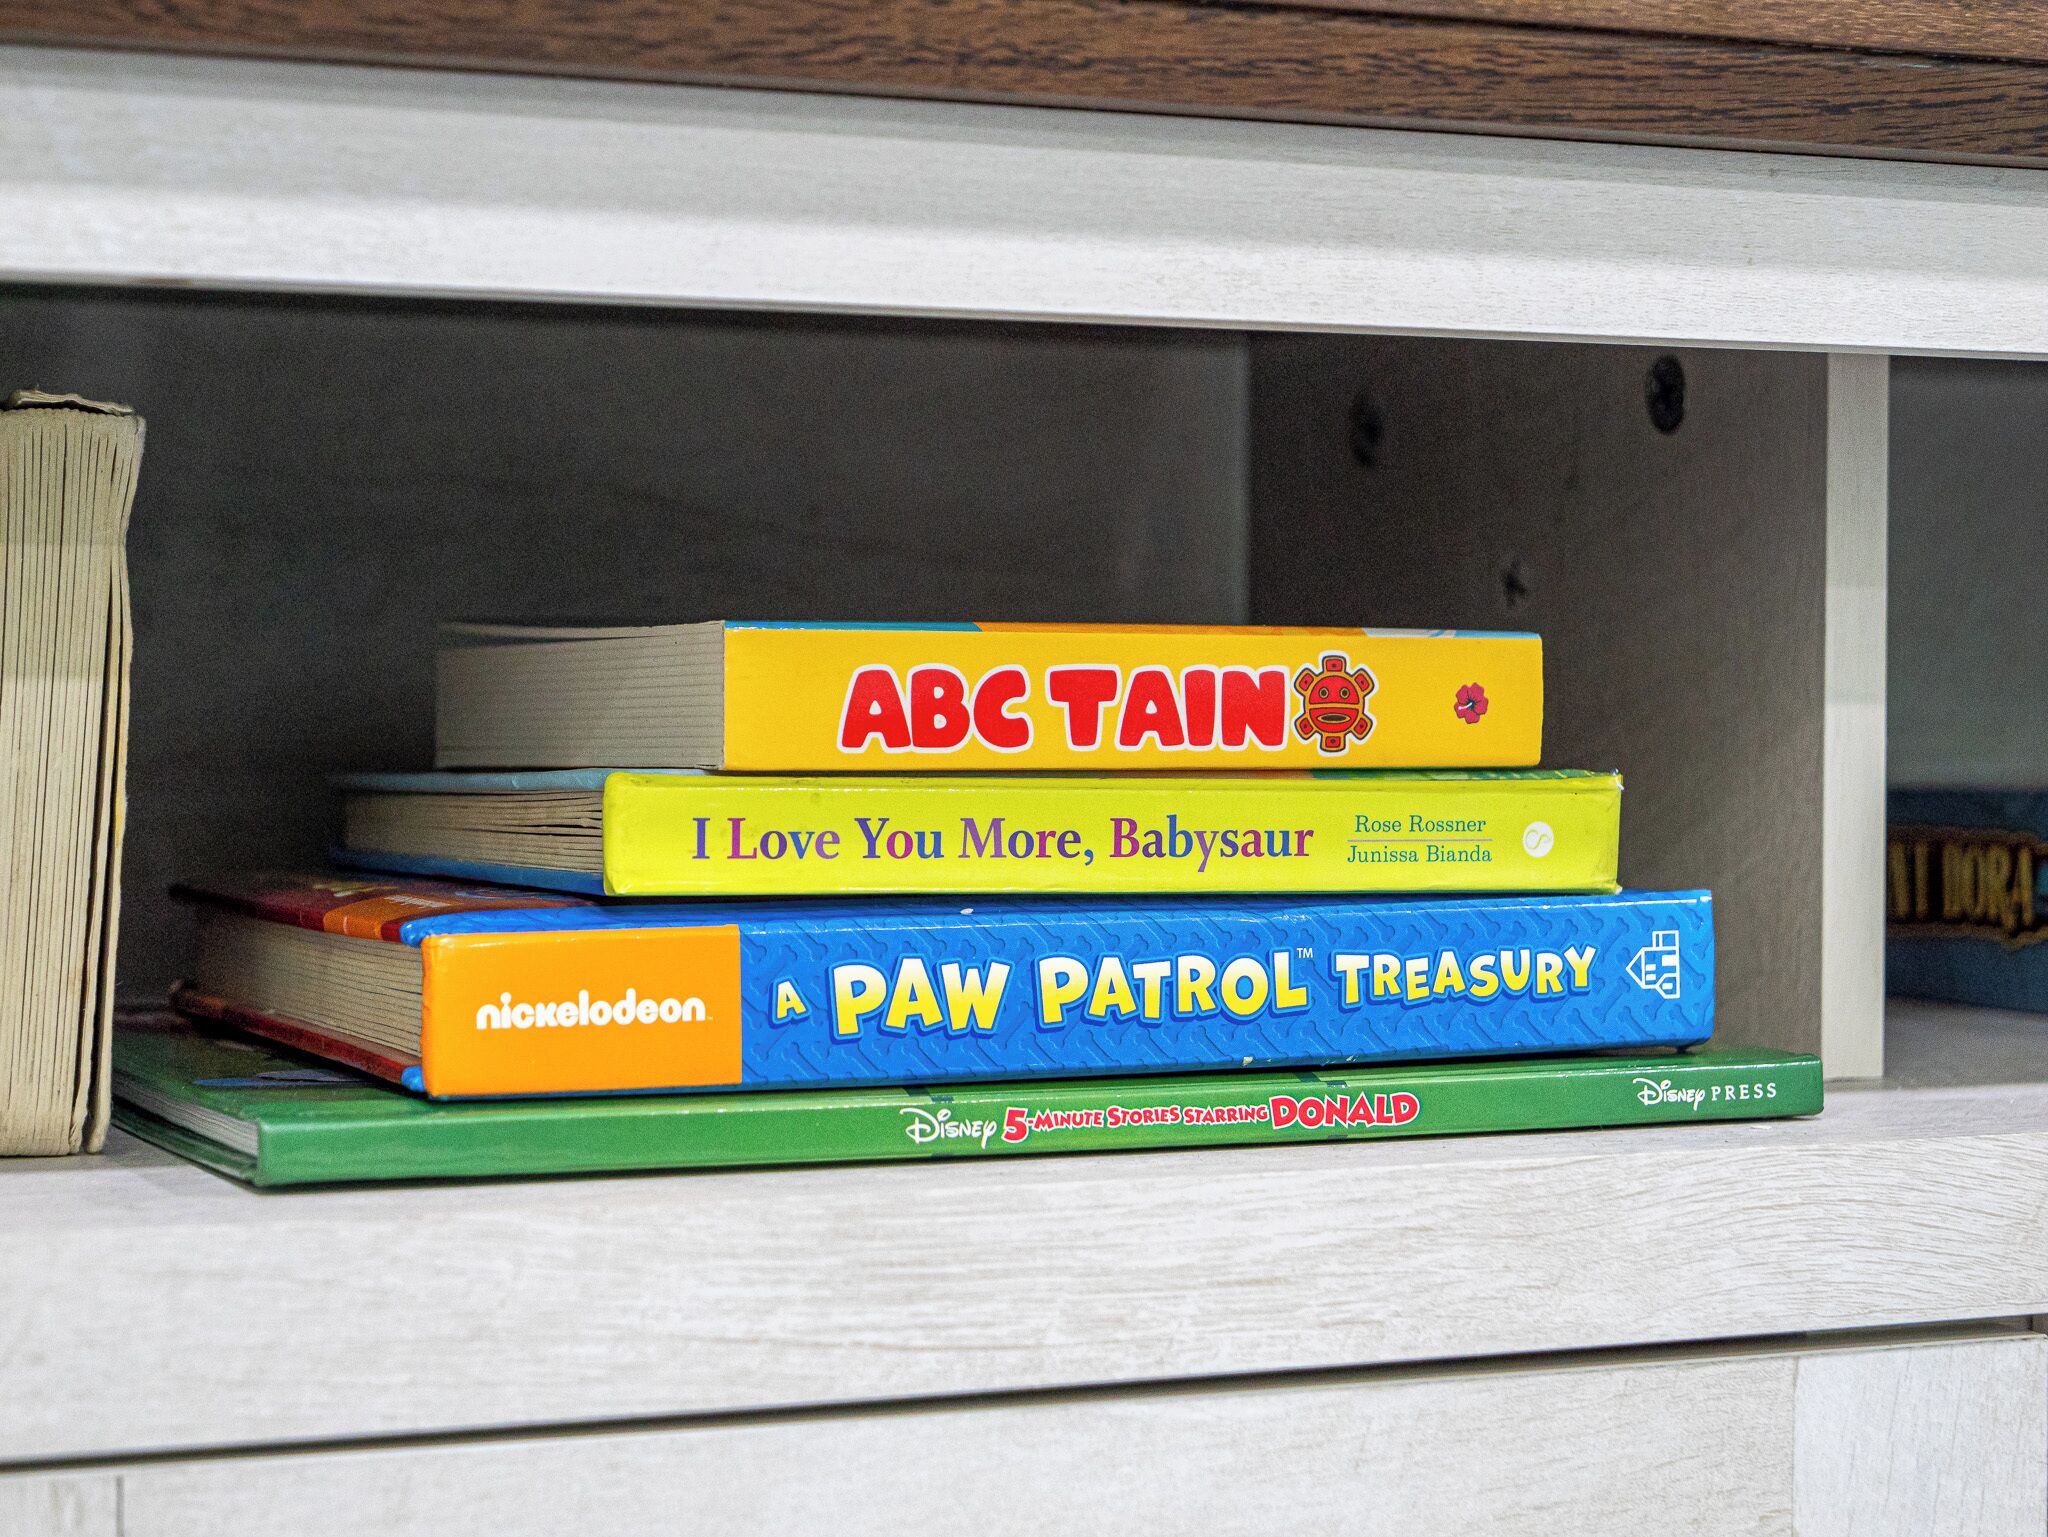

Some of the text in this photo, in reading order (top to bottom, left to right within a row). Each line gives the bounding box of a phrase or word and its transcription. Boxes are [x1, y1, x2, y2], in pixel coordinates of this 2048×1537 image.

[838, 664, 1290, 753] ABC TAIN
[691, 813, 1315, 873] I Love You More, Babysaur
[1354, 815, 1488, 833] Rose Rossner
[1346, 844, 1493, 863] Junissa Bianda
[475, 987, 708, 1030] nickelodeon
[775, 979, 808, 1020] A
[832, 956, 1012, 1036] PAW
[1037, 951, 1309, 1025] PATROL
[1334, 945, 1598, 1004] TREASURY
[1632, 1077, 1778, 1112] Disney PRESS
[899, 1091, 1421, 1150] Disney 5-MINUTE STORIES STARRING DONALD
